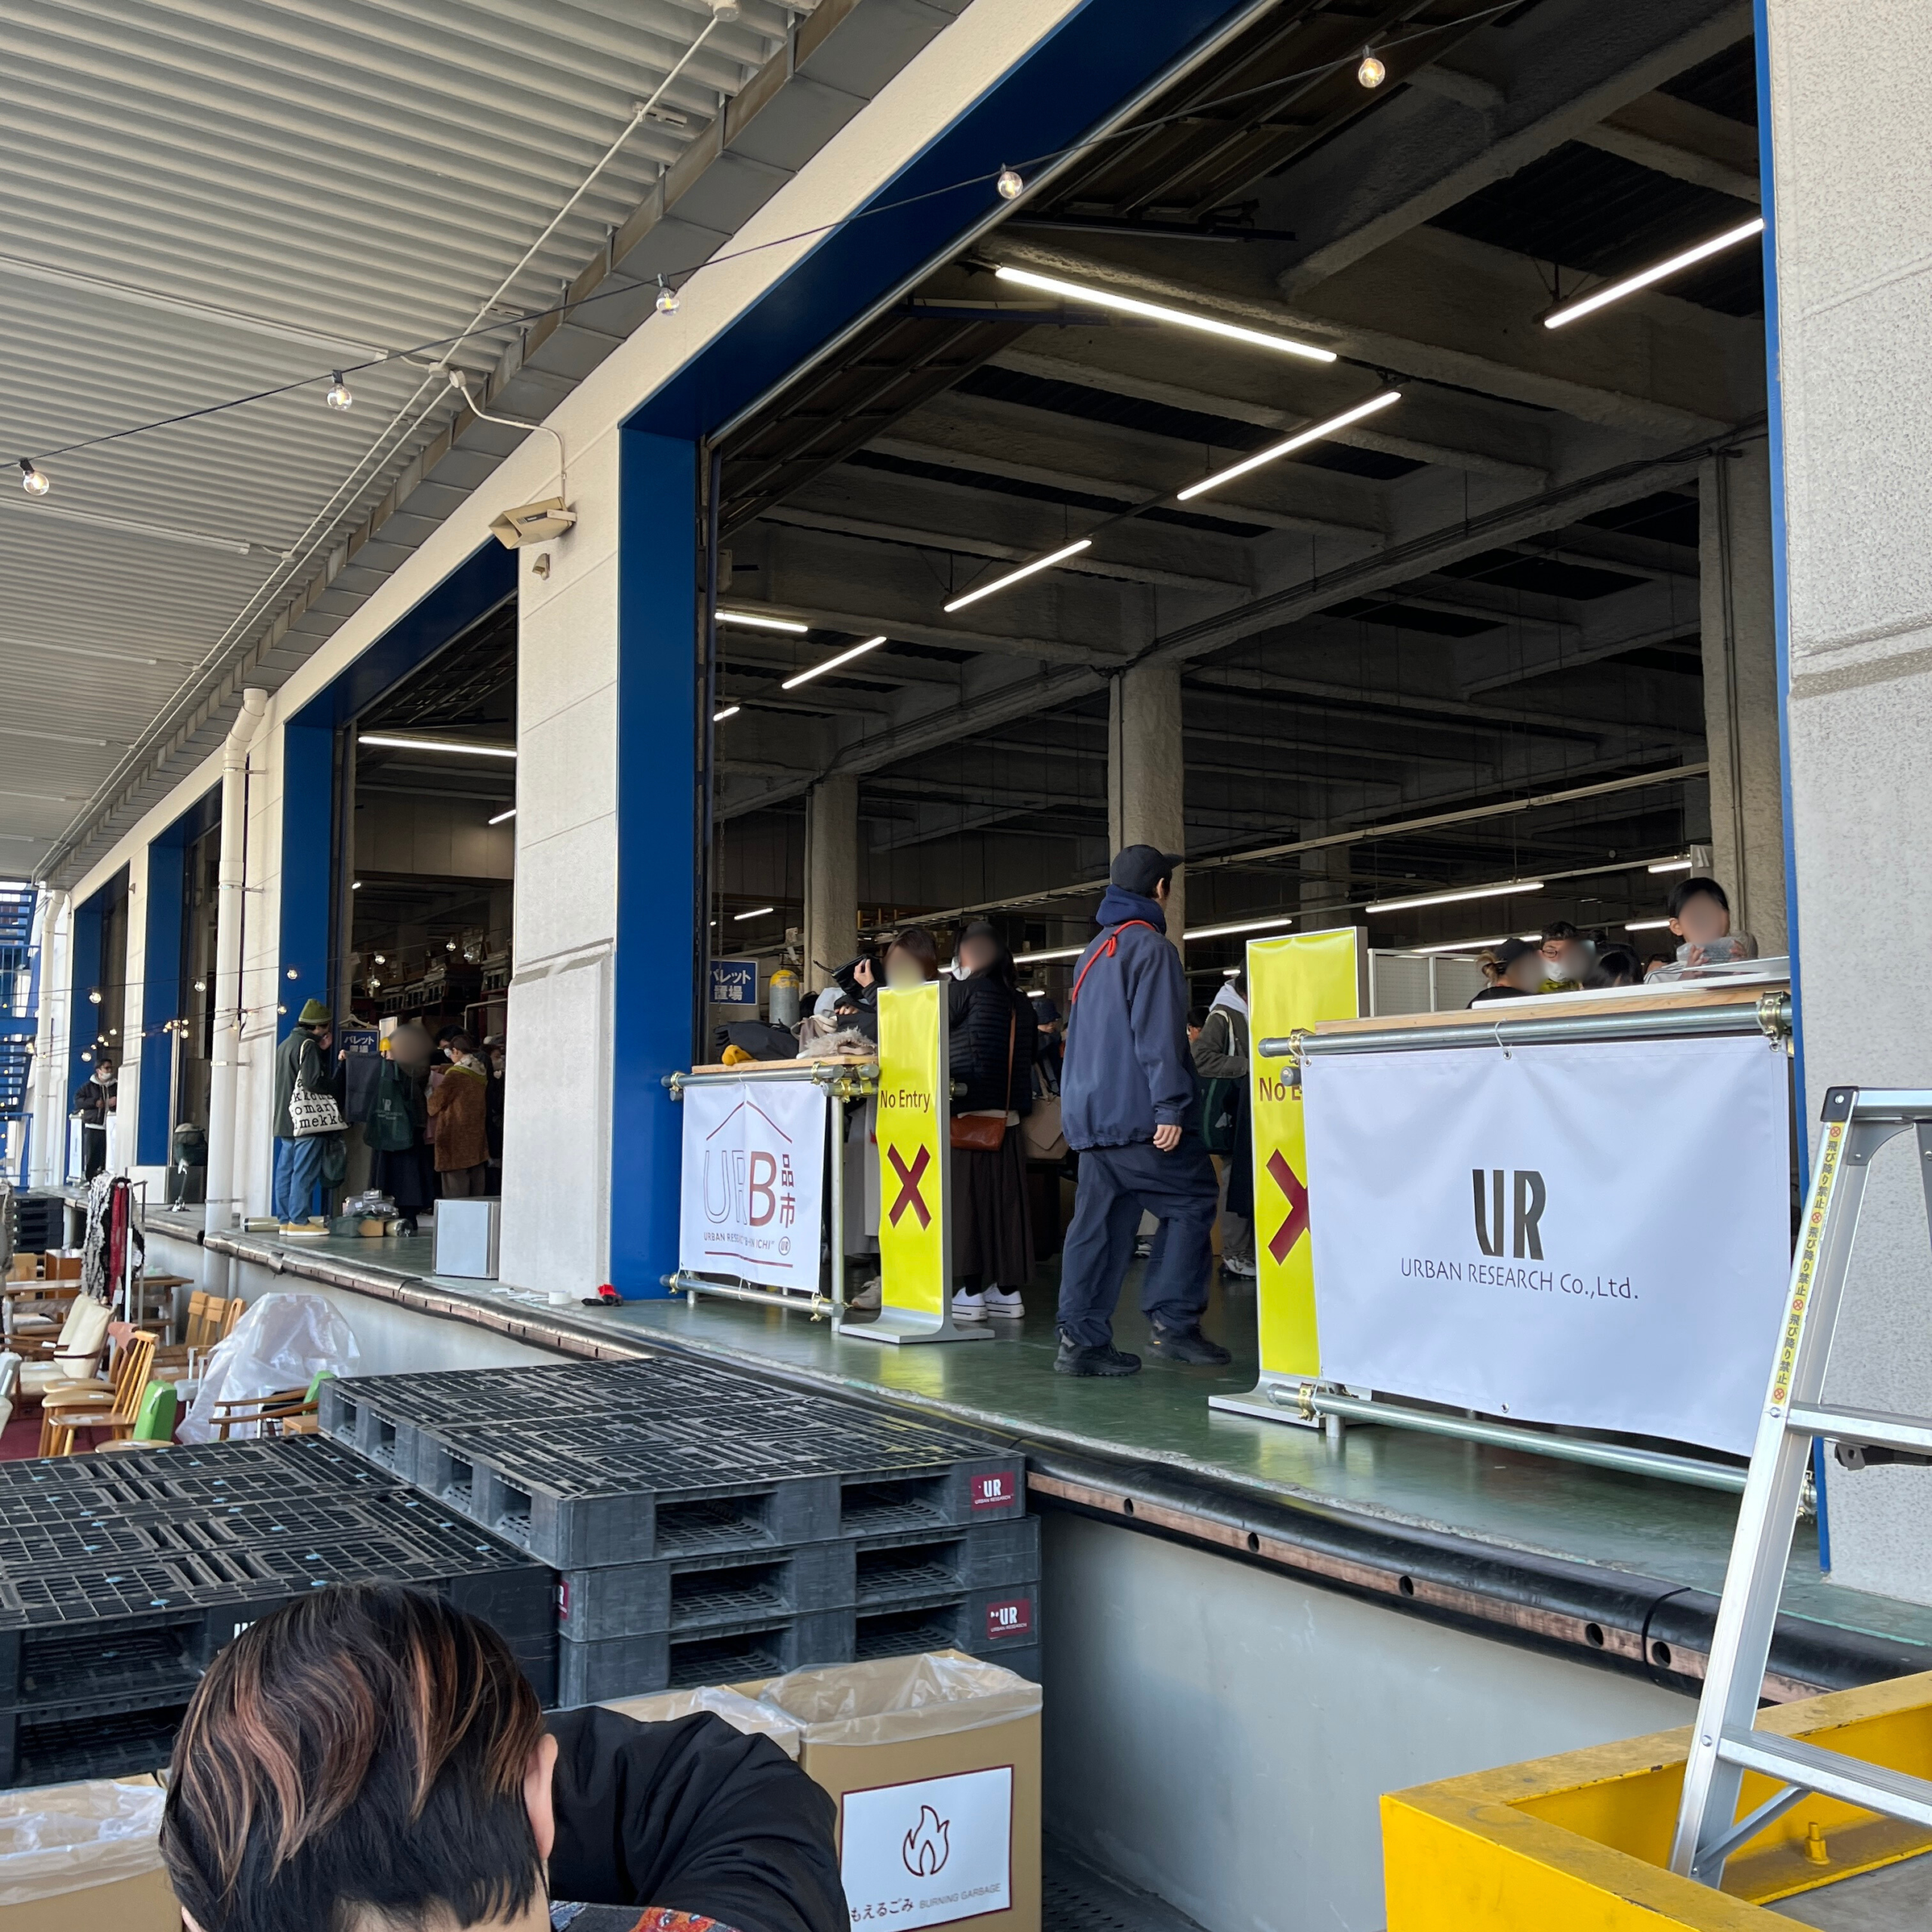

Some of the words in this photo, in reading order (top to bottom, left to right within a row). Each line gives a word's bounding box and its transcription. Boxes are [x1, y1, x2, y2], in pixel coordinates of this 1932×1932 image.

[714, 985, 743, 1001] 置場
[881, 1090, 896, 1108] No
[899, 1090, 931, 1113] Entry
[1260, 1077, 1286, 1101] No
[780, 1154, 795, 1228] 品市
[1814, 1140, 1838, 1209] 飛び降り禁止
[1472, 1169, 1546, 1260] UR
[703, 1232, 725, 1241] URBAN
[1401, 1257, 1462, 1281] URBAN
[1469, 1263, 1552, 1292] RESEARCH
[1560, 1273, 1638, 1299] Co.,Ltd.
[1795, 1226, 1819, 1297] 飛び降り禁止
[1777, 1314, 1800, 1385] 飛び降り禁止
[983, 1479, 1001, 1497] UR
[999, 1607, 1017, 1625] UR
[851, 1898, 915, 1922] もえるごみ
[919, 1893, 958, 1909] BURNING
[961, 1883, 1001, 1900] GARBAGE
